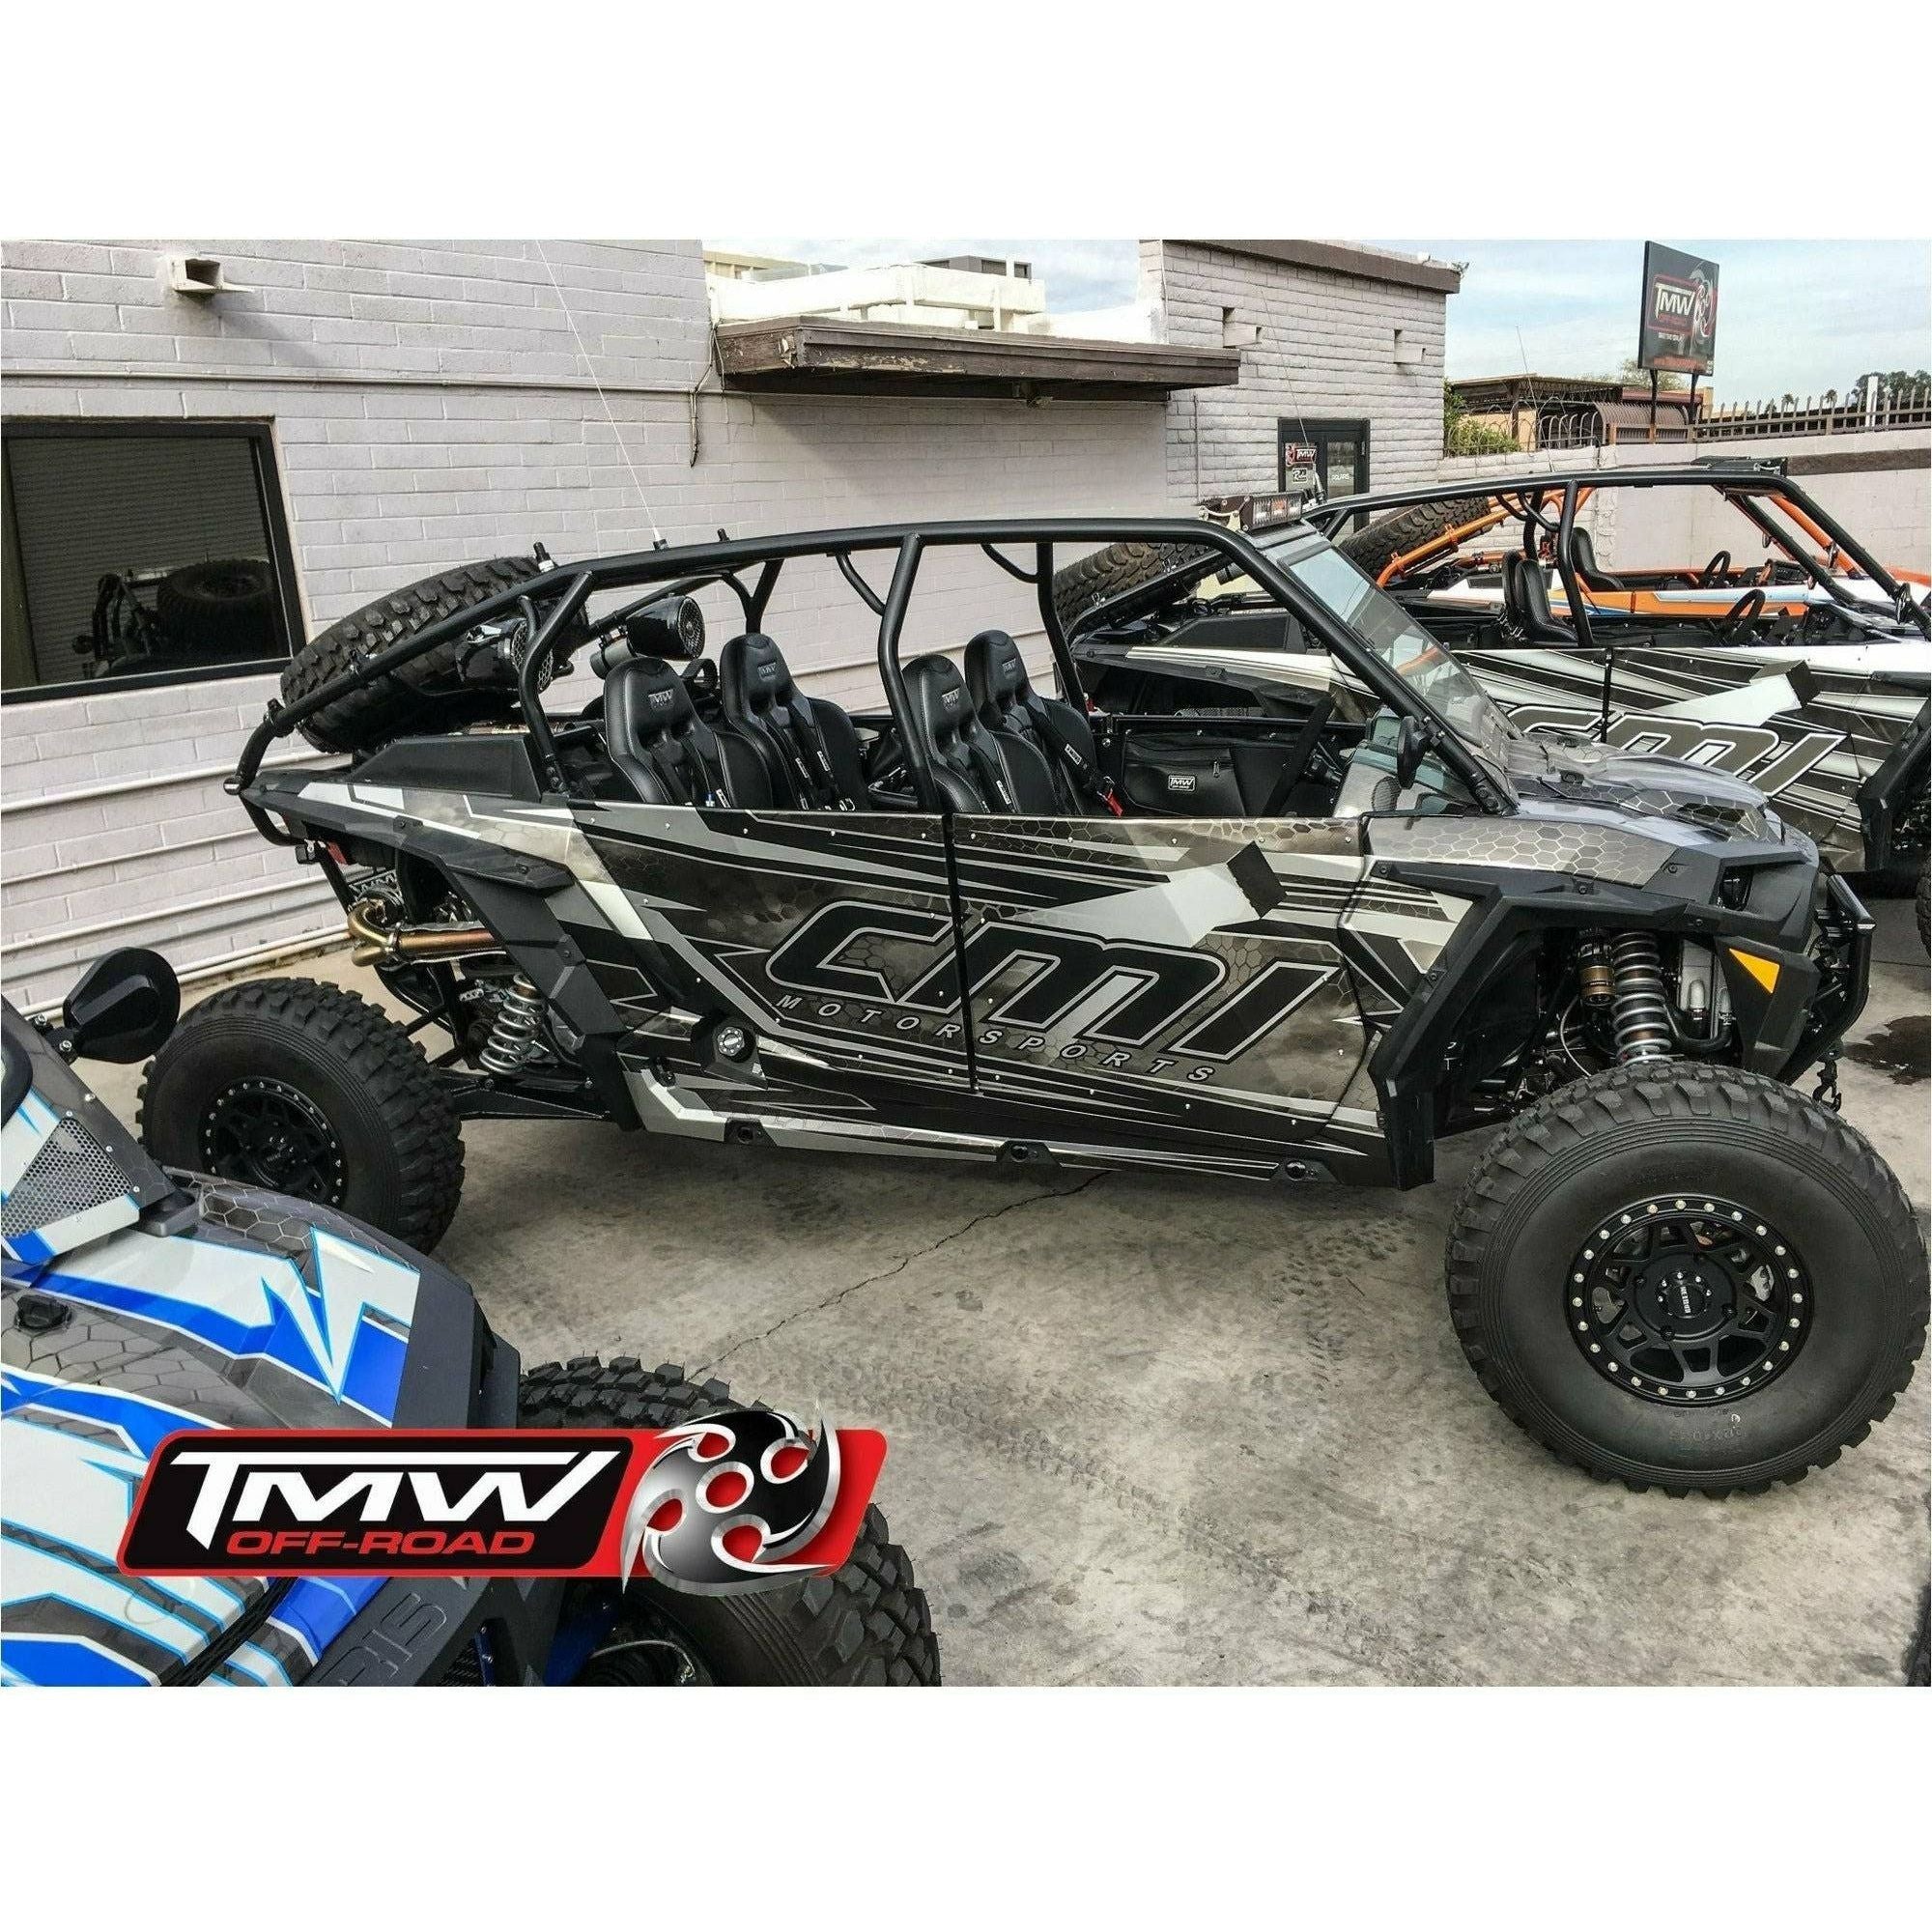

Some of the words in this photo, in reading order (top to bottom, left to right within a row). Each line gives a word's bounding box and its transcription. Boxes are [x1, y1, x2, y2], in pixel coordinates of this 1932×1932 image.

[1655, 282, 1695, 320] TMW
[1296, 449, 1316, 460] TMW
[1170, 778, 1194, 786] TMW
[775, 992, 1215, 1084] MOTORSPORTS
